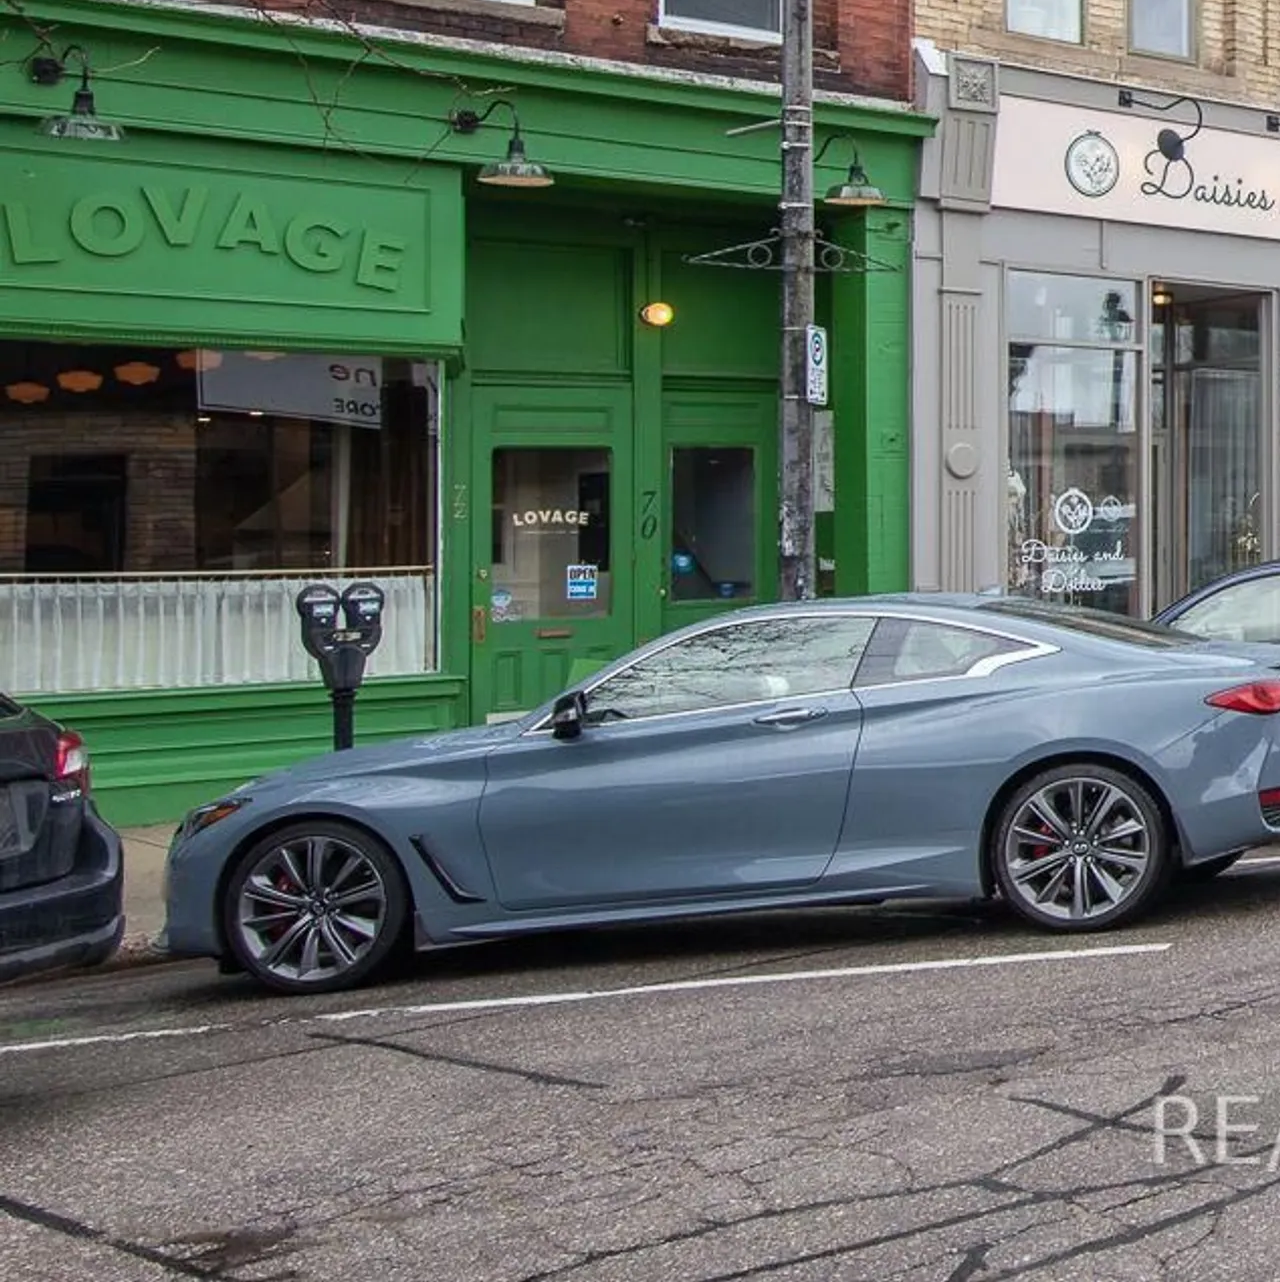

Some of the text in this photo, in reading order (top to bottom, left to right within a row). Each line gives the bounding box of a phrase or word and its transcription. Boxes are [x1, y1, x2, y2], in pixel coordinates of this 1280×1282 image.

[1141, 149, 1275, 211] Daisies
[2, 186, 405, 293] LOVAGE
[512, 509, 590, 526] LOVAGE
[569, 567, 596, 580] OPEN
